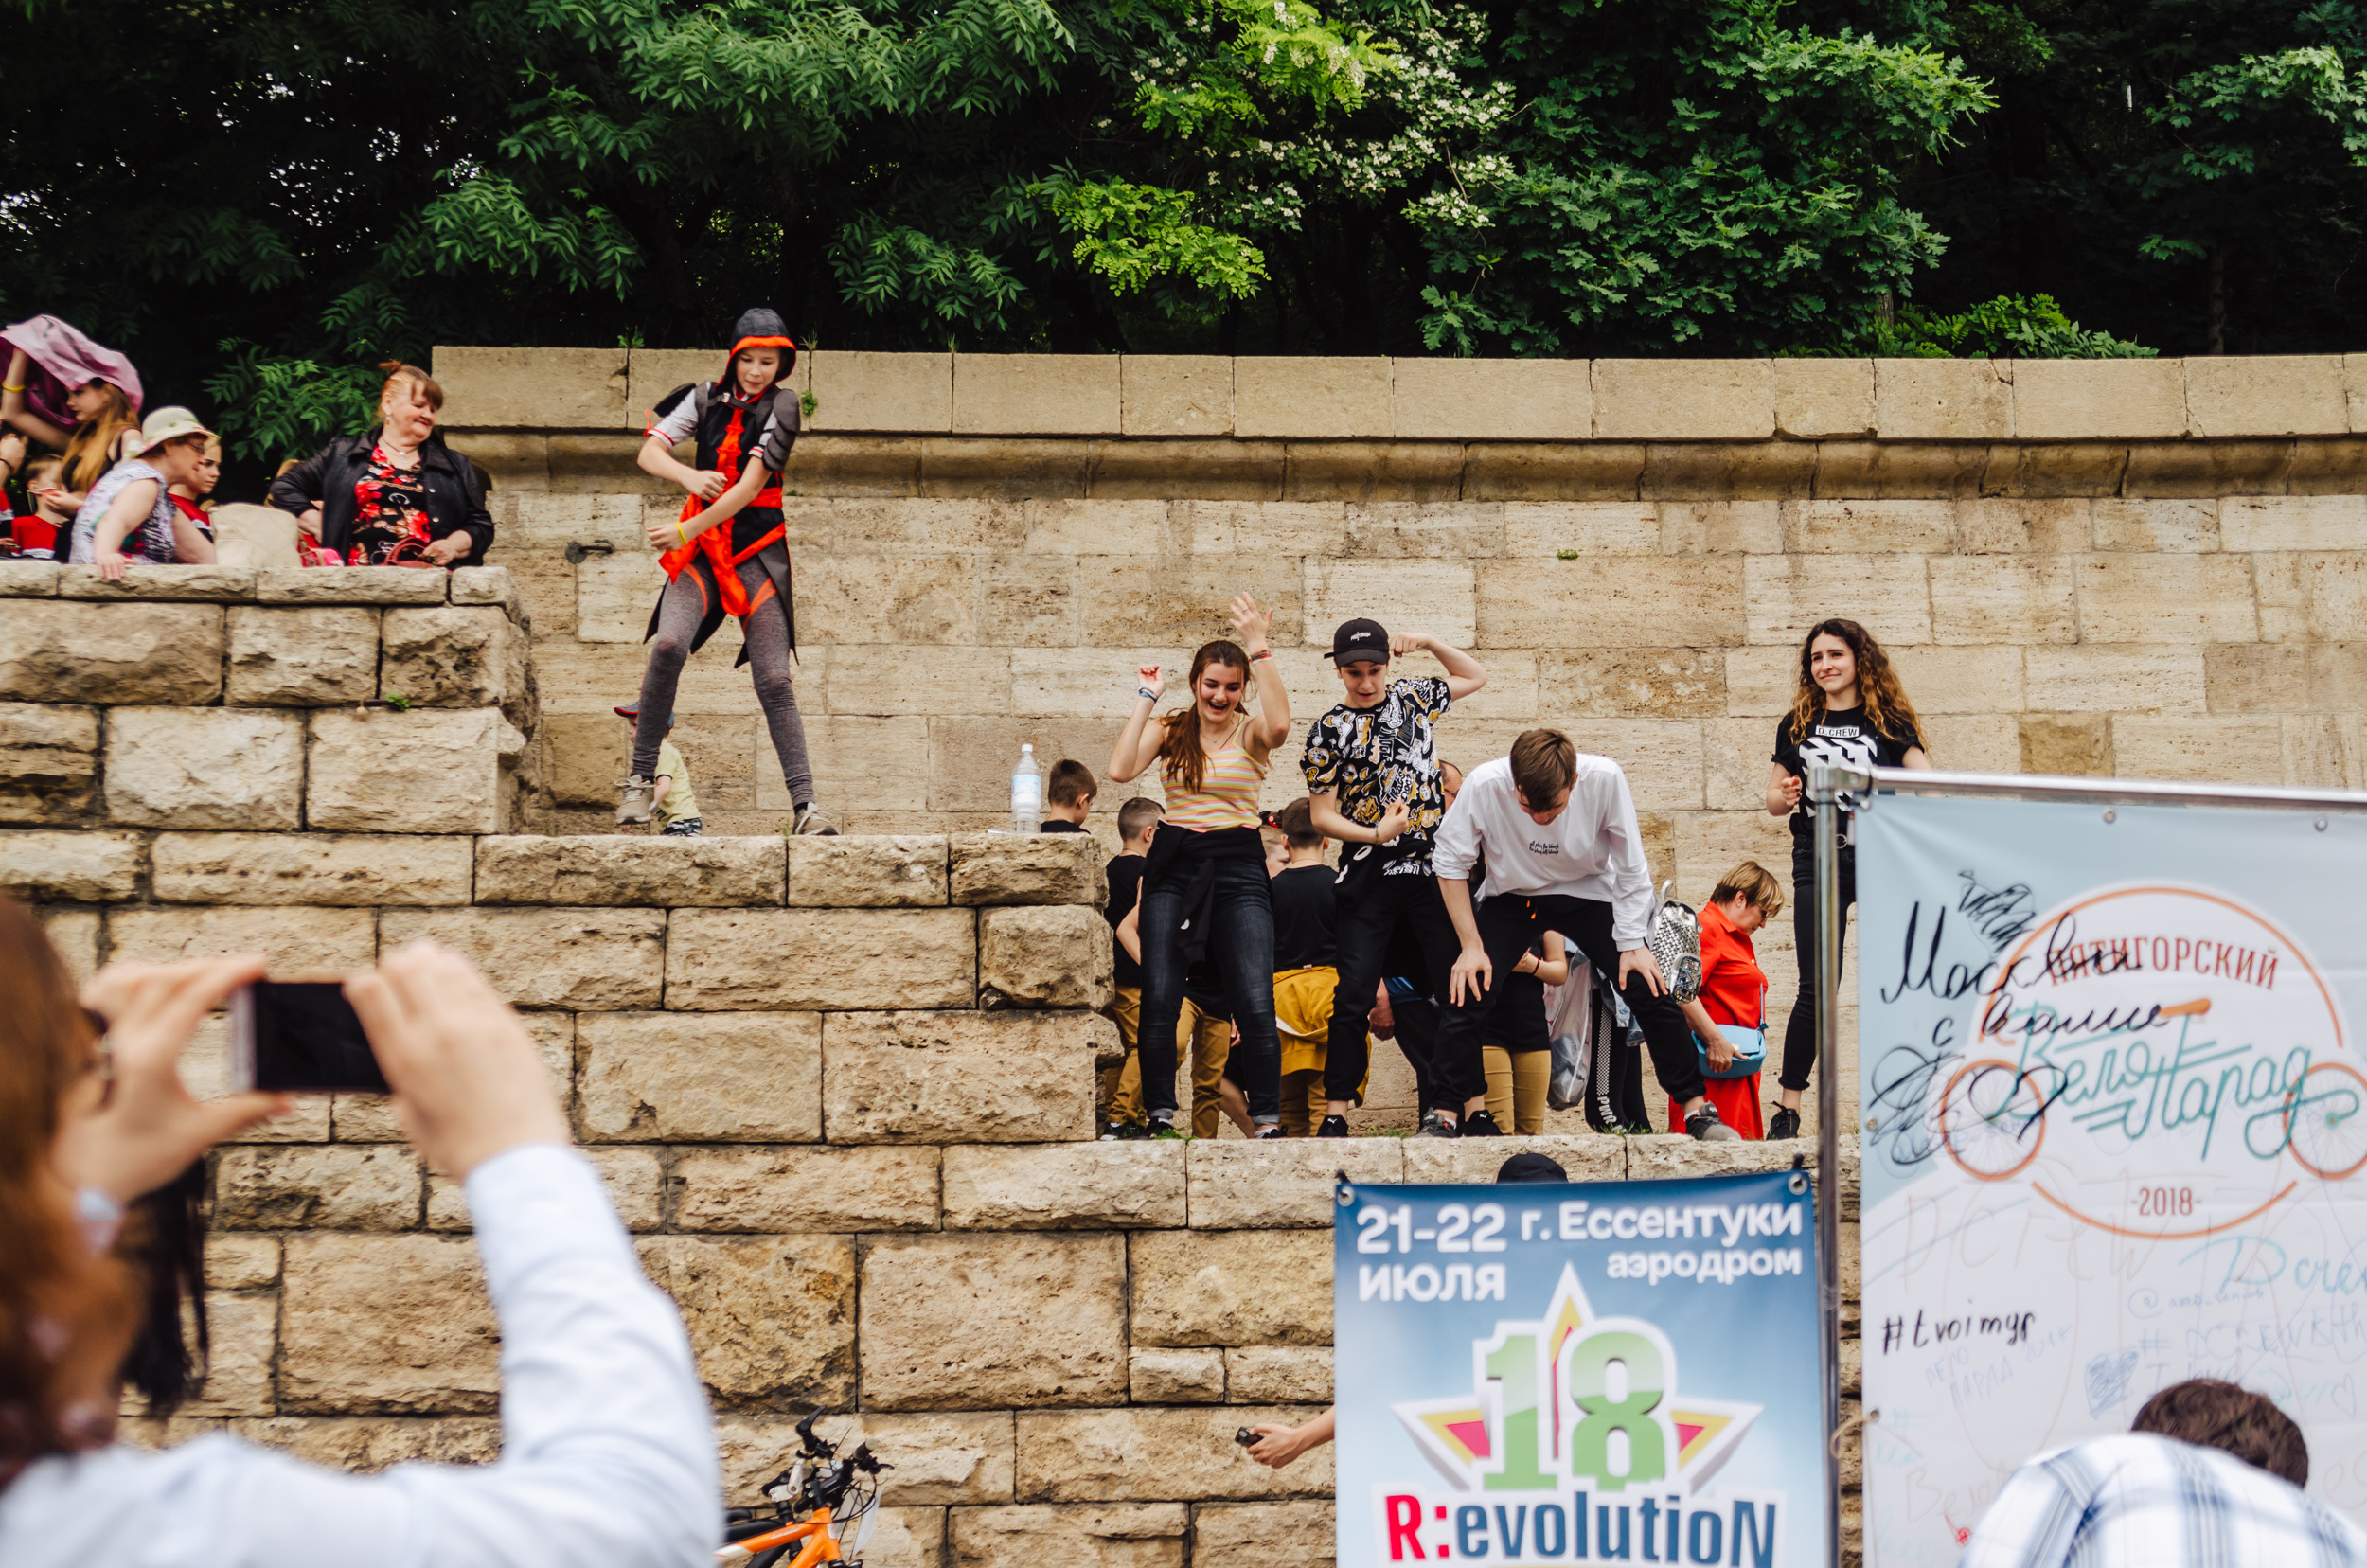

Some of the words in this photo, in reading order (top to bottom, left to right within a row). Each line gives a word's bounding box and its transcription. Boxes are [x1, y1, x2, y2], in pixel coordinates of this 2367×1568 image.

[1880, 900, 2143, 1004] Москва
[2047, 935, 2279, 990] ПЯТИГОРСКИЙ
[1356, 1203, 1508, 1255] 21-22
[1521, 1208, 1553, 1241] г.
[1558, 1200, 1803, 1248] Ессентуки
[1606, 1246, 1804, 1286] аэродром
[1483, 1330, 1667, 1492] 18
